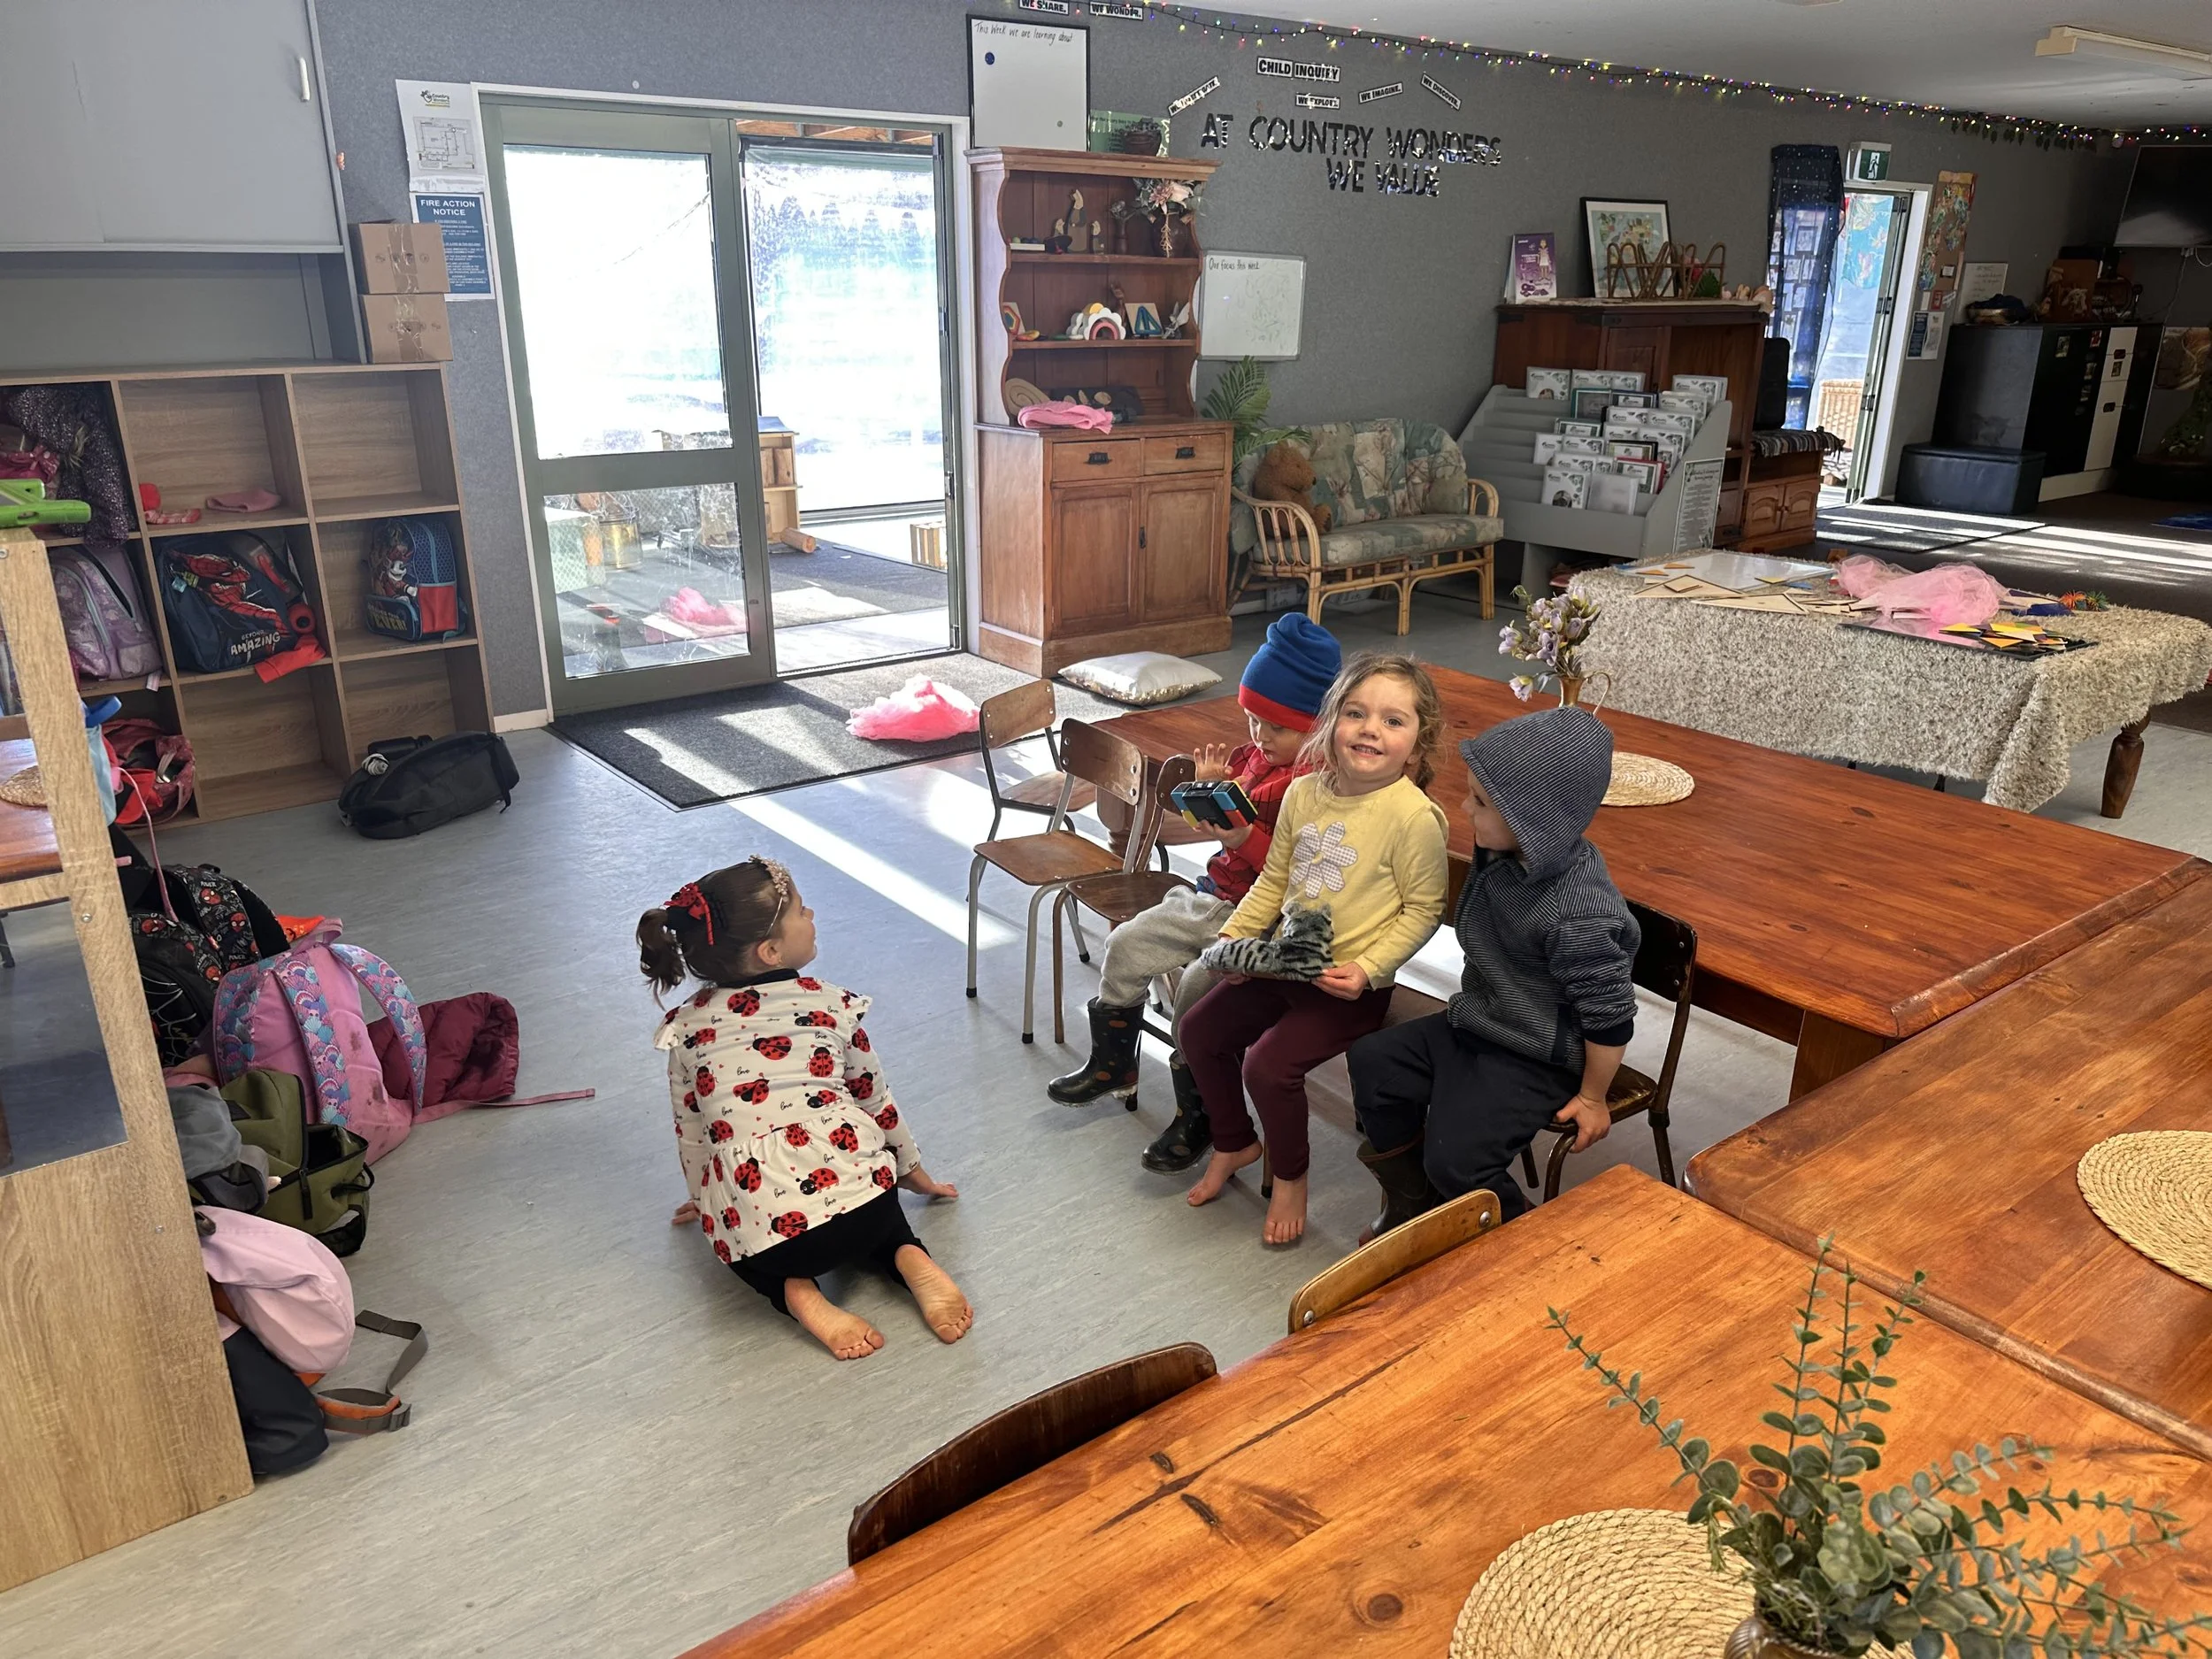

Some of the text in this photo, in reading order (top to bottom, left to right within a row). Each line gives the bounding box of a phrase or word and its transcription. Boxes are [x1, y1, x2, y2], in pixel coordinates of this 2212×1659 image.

[975, 21, 987, 34] This
[1009, 28, 1018, 37] we
[1021, 30, 1031, 39] are
[1033, 27, 1056, 46] learning
[1258, 59, 1291, 74] CHILD
[1423, 76, 1432, 87] WE
[1361, 85, 1401, 101] WE IMAGINE.
[1201, 113, 1502, 166] AT COUNTRY WONDERS
[1325, 157, 1440, 198] WE VALUE
[230, 632, 280, 656] AMAZING
[827, 1005, 840, 1014] love
[710, 1015, 723, 1025] love
[815, 1031, 828, 1040] love
[736, 1066, 750, 1076] love
[721, 1106, 733, 1117] love
[780, 1101, 794, 1111] love
[824, 1153, 836, 1164] love
[774, 1188, 787, 1199] love
[825, 1197, 837, 1208] love
